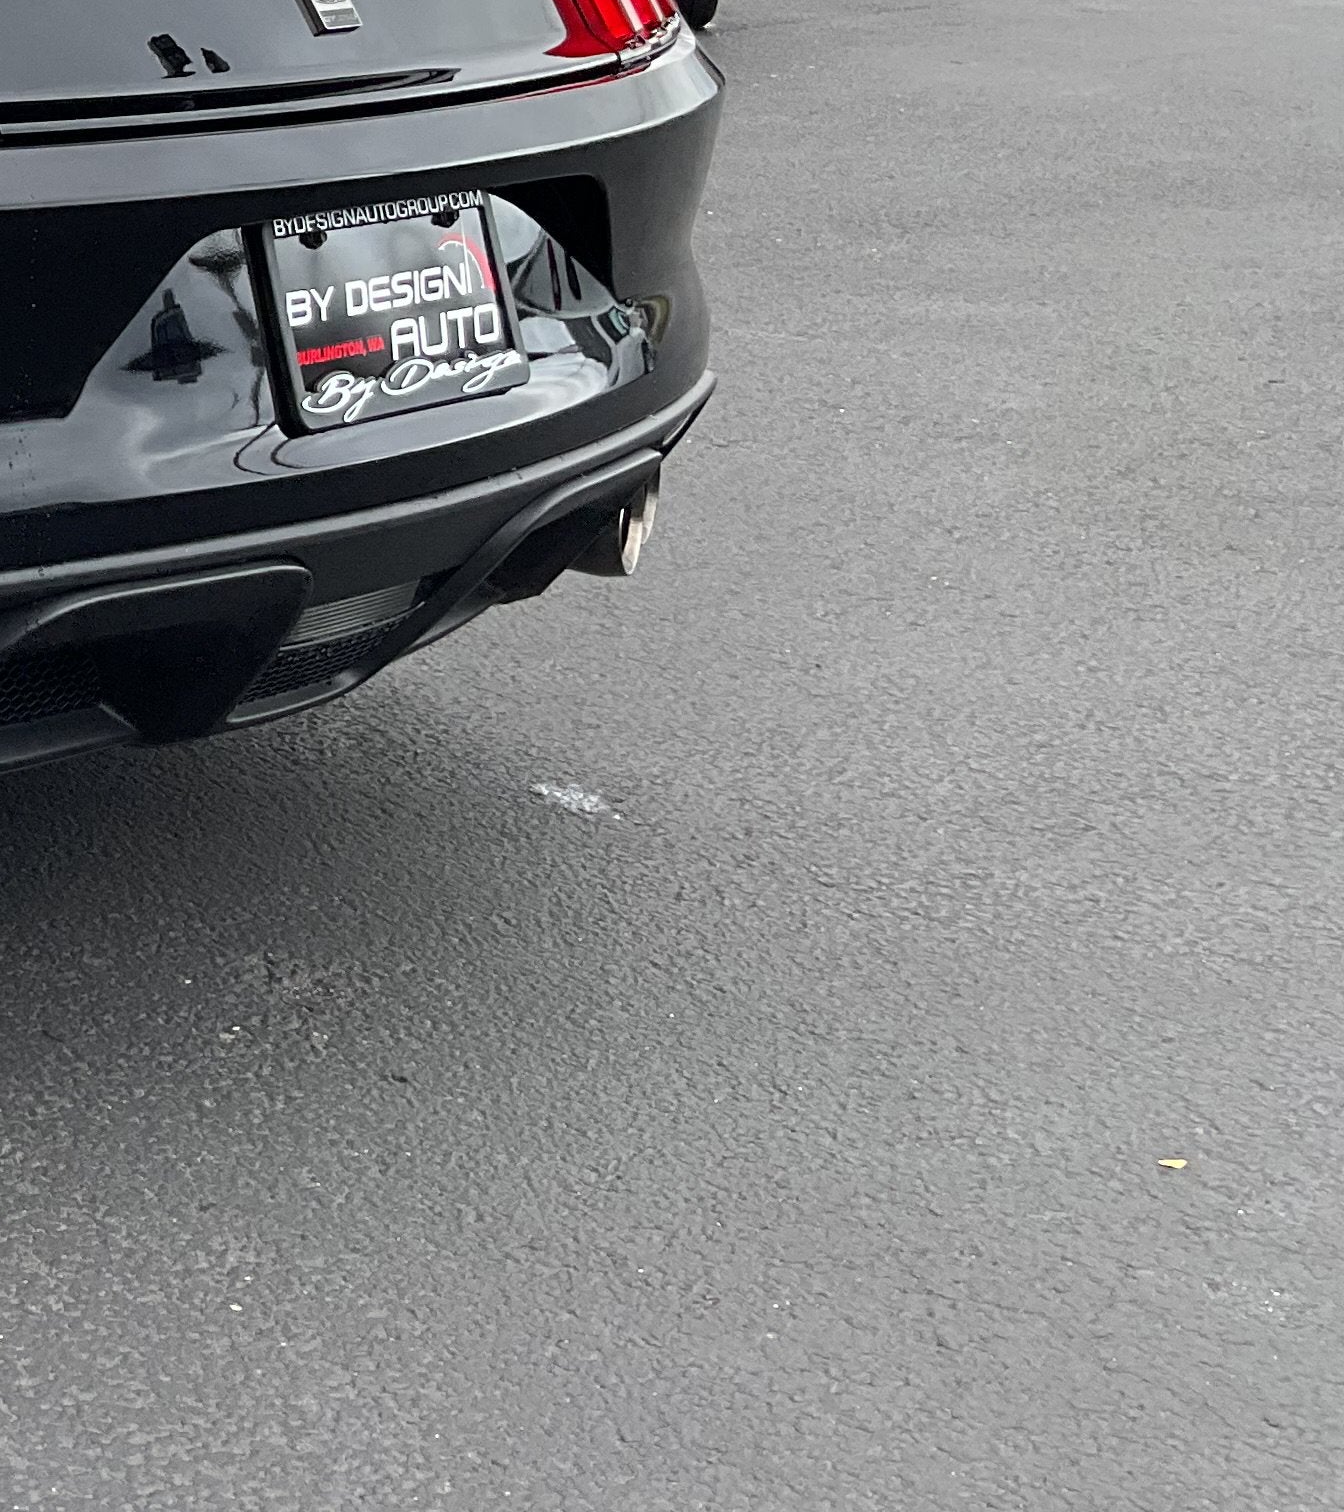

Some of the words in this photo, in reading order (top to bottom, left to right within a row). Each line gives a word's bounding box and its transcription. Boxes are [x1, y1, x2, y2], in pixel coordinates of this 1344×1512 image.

[273, 189, 484, 237] BYDESIGNAUTOGROUPCOM
[285, 285, 335, 327] BY
[344, 262, 467, 317] DESIGN
[390, 303, 502, 361] AUTO
[301, 372, 376, 423] By
